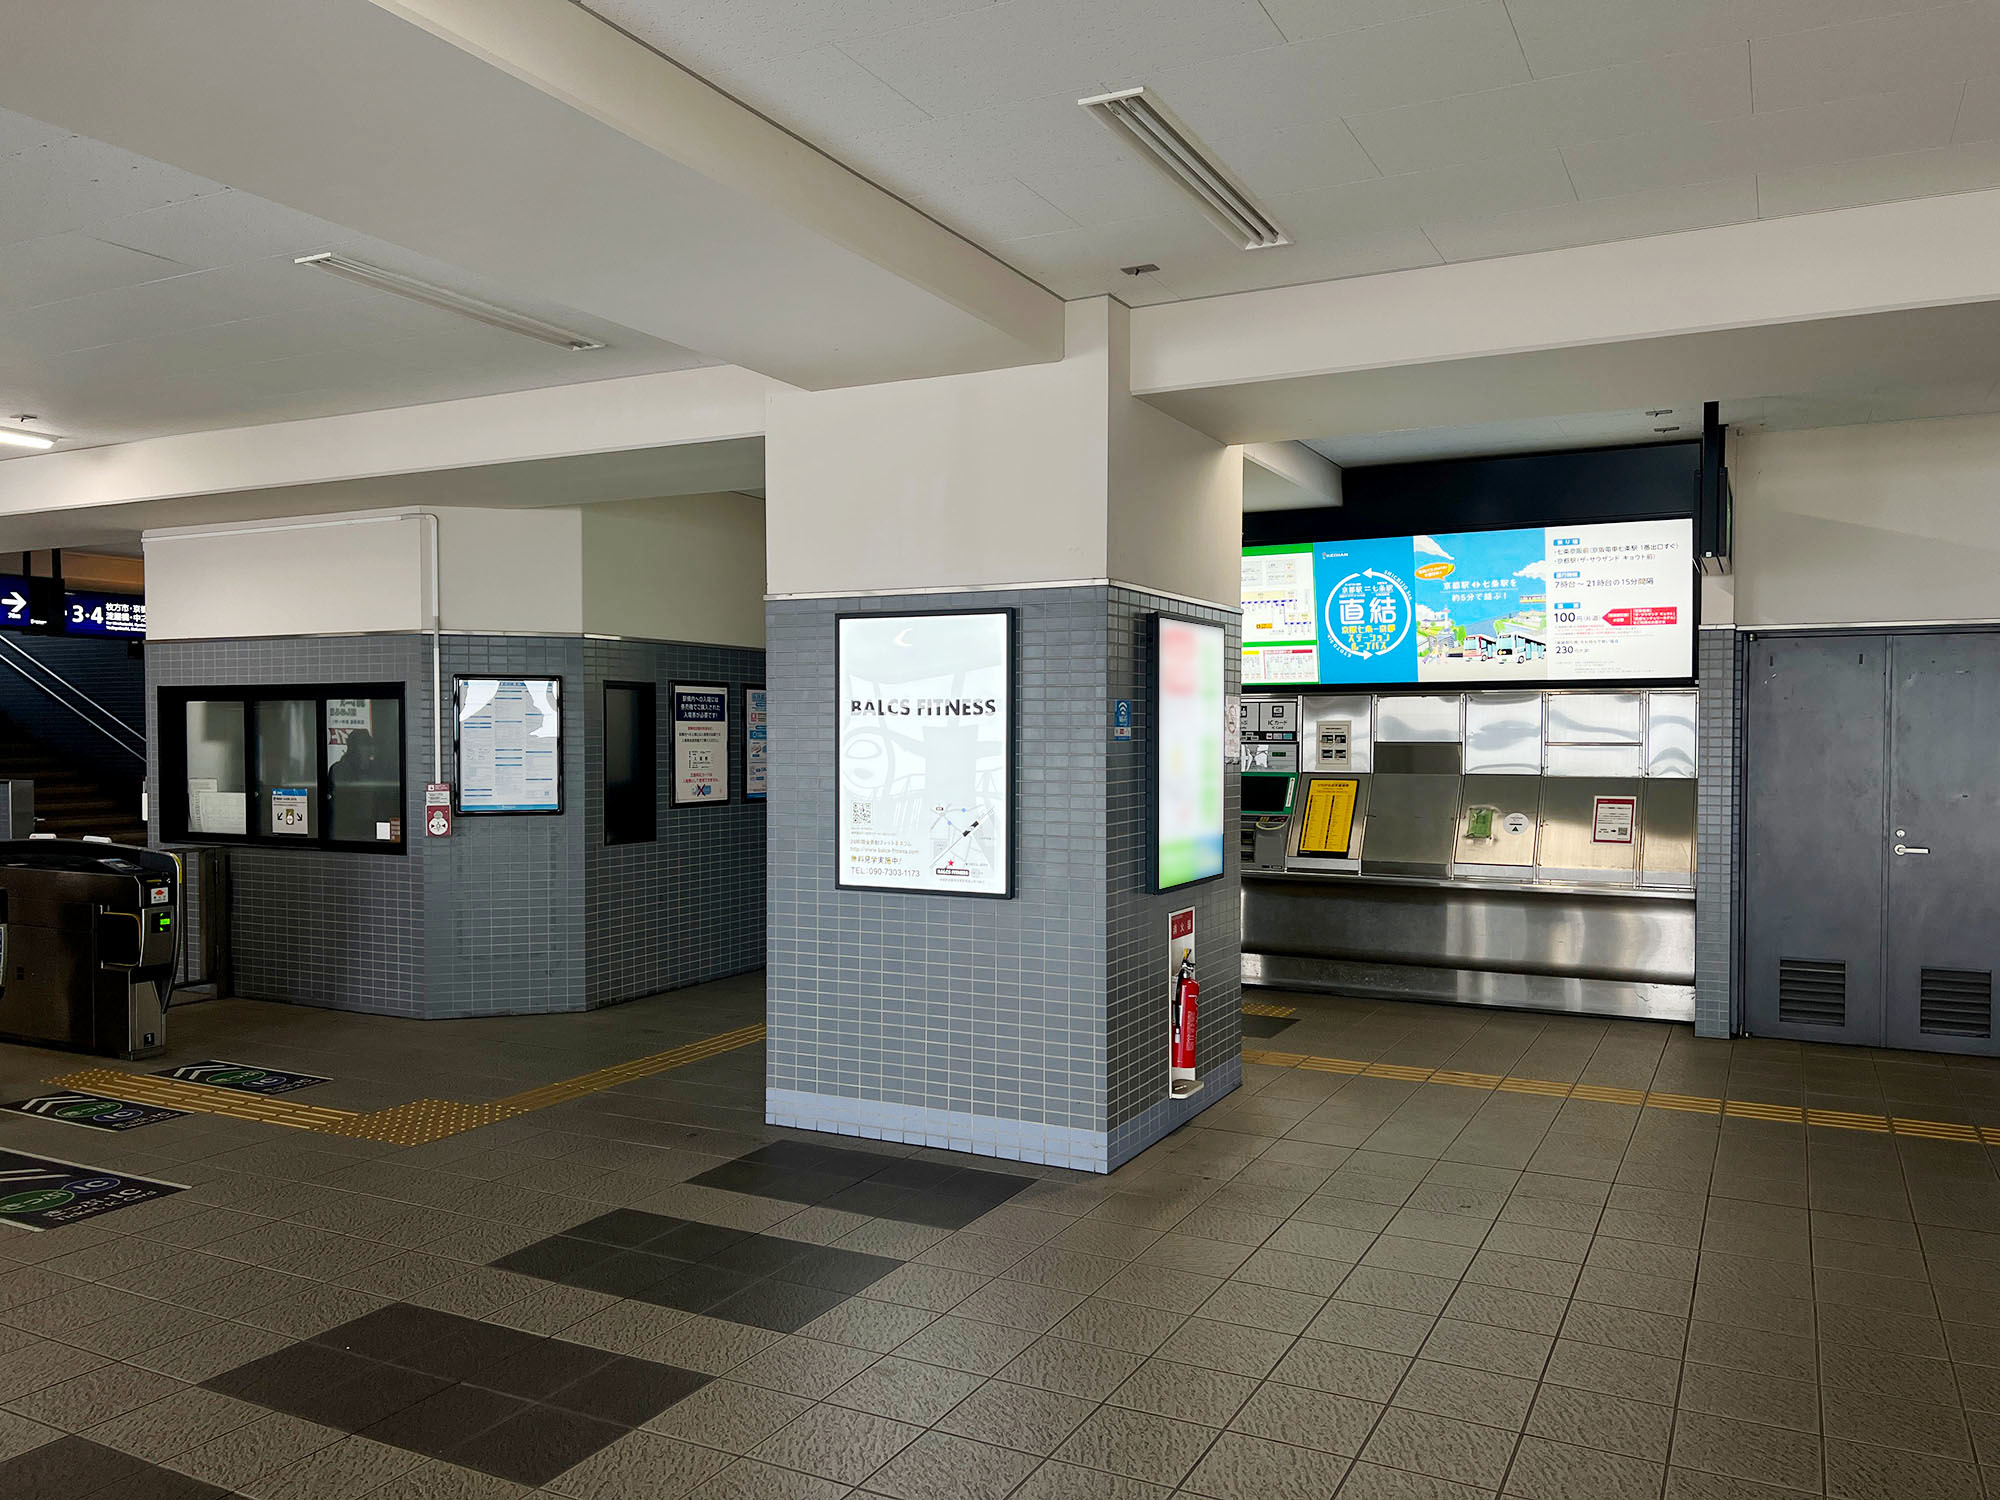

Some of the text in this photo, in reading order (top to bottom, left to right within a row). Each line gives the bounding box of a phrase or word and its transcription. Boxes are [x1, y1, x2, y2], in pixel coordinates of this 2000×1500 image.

[1339, 596, 1397, 625] 直結
[1348, 632, 1390, 643] ステーション
[1351, 642, 1388, 651] ループバス
[850, 698, 997, 717] BALCS FITNESS
[104, 1111, 133, 1120] IC
[73, 1180, 110, 1191] IC
[4, 1190, 68, 1212] きっぷ
